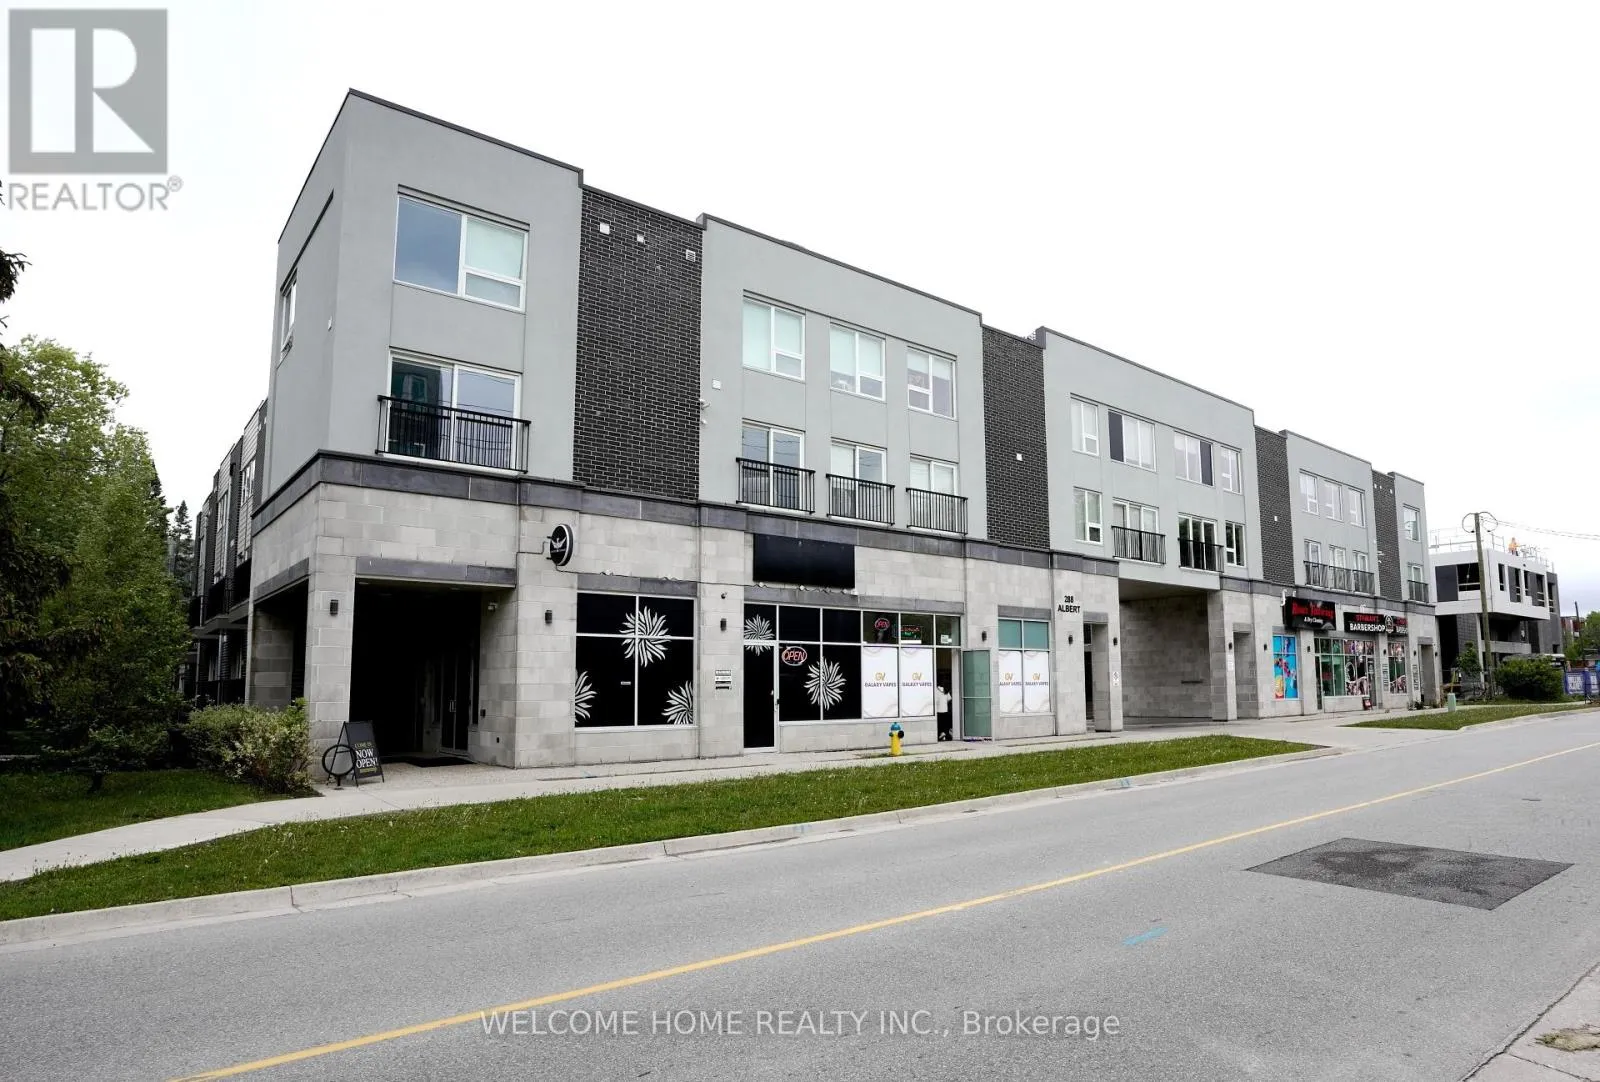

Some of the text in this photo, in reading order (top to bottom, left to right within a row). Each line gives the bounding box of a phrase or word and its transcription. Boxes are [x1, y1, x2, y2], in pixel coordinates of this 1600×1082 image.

[1064, 595, 1074, 603] 288
[1058, 604, 1080, 613] ALBERT
[875, 620, 888, 628] OPEN
[1349, 622, 1385, 632] BARBERSHOP
[784, 650, 806, 661] OPEN
[355, 748, 373, 760] NOW
